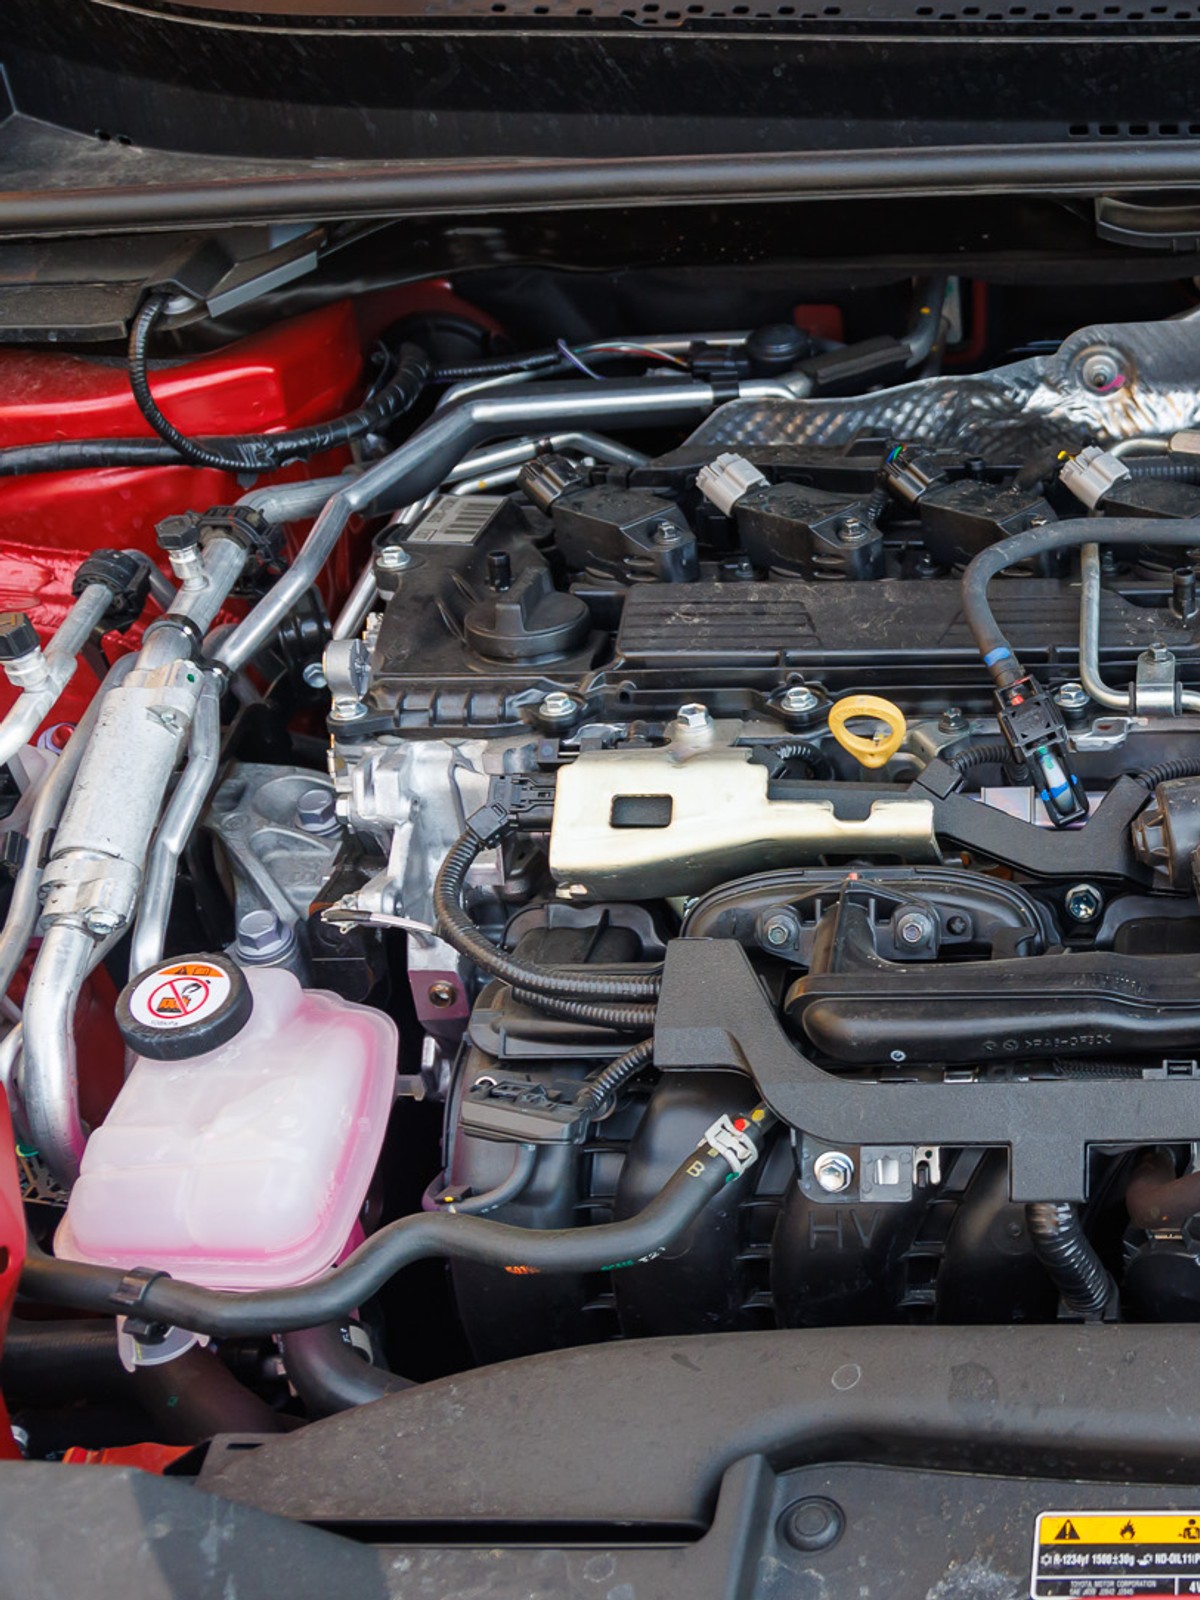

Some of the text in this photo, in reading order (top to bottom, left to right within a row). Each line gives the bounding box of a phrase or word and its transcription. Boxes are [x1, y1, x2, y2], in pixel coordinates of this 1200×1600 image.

[686, 1160, 705, 1178] B
[808, 1208, 881, 1250] HV
[1053, 1552, 1090, 1567] R-1234yf
[1070, 1580, 1157, 1588] TOYOTA MOTOR CORPORATION
